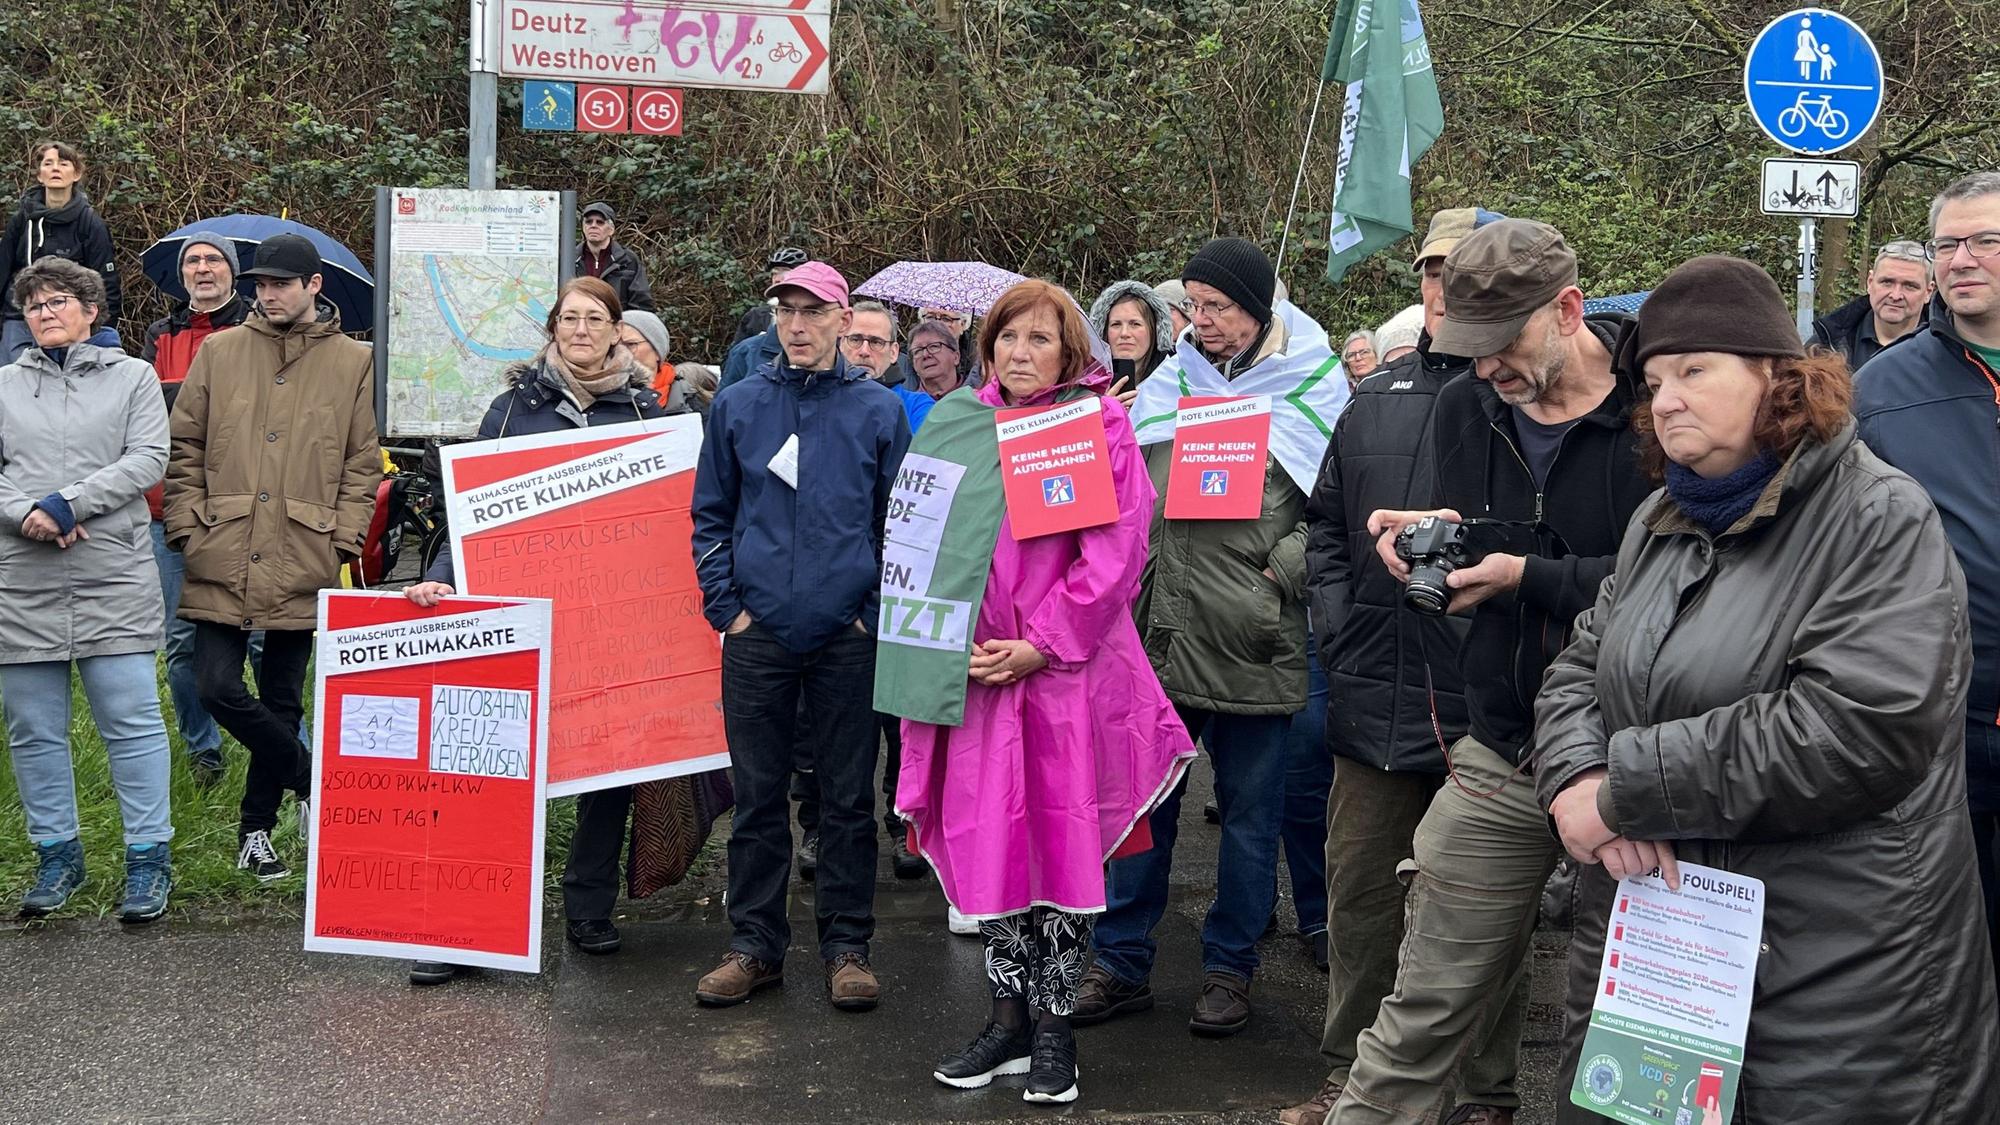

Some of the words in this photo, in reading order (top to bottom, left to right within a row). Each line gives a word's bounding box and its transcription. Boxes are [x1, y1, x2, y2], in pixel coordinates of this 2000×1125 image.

[511, 7, 587, 34] Deutz
[511, 43, 656, 74] Westhoven
[591, 100, 615, 117] 51
[644, 103, 671, 120] 45
[1389, 380, 1413, 390] JAKO
[1002, 424, 1026, 435] ROTE
[1027, 405, 1084, 429] KLIMAKARTE
[1181, 412, 1202, 422] ROTE
[1204, 403, 1257, 418] KLIMAKARTE
[1011, 449, 1049, 464] KEINE
[1051, 440, 1094, 455] NEUEN
[1180, 453, 1255, 463] AUTOBAHNEN
[1182, 442, 1215, 452] KEINE
[1218, 442, 1256, 451] NEUEN
[1013, 452, 1096, 476] AUTOBAHNEN
[468, 476, 544, 505] KLIMASCHUTZ
[547, 452, 624, 481] AUSBREMSEN?
[472, 494, 529, 524] ROTE
[533, 454, 667, 506] KLIMAKARTE
[476, 519, 649, 562] LEVERKUSEN
[522, 552, 596, 578] ERSTE
[337, 628, 406, 645] KLIMASCHUTZ
[409, 617, 481, 636] AUSBREMSEN?
[881, 595, 956, 644] TZT.
[339, 644, 389, 666] ROTE
[395, 627, 516, 659] KLIMAKARTE
[552, 639, 597, 665] EITE
[607, 627, 682, 657] BRÜCKE
[432, 688, 529, 721] AUTOBAHN
[432, 715, 501, 746] KREUZ
[430, 743, 529, 779] LEVERKUSEN
[322, 807, 382, 828] JEDEN
[1682, 873, 1755, 902] FOULSPIEL!
[1639, 1064, 1663, 1082] VCD
